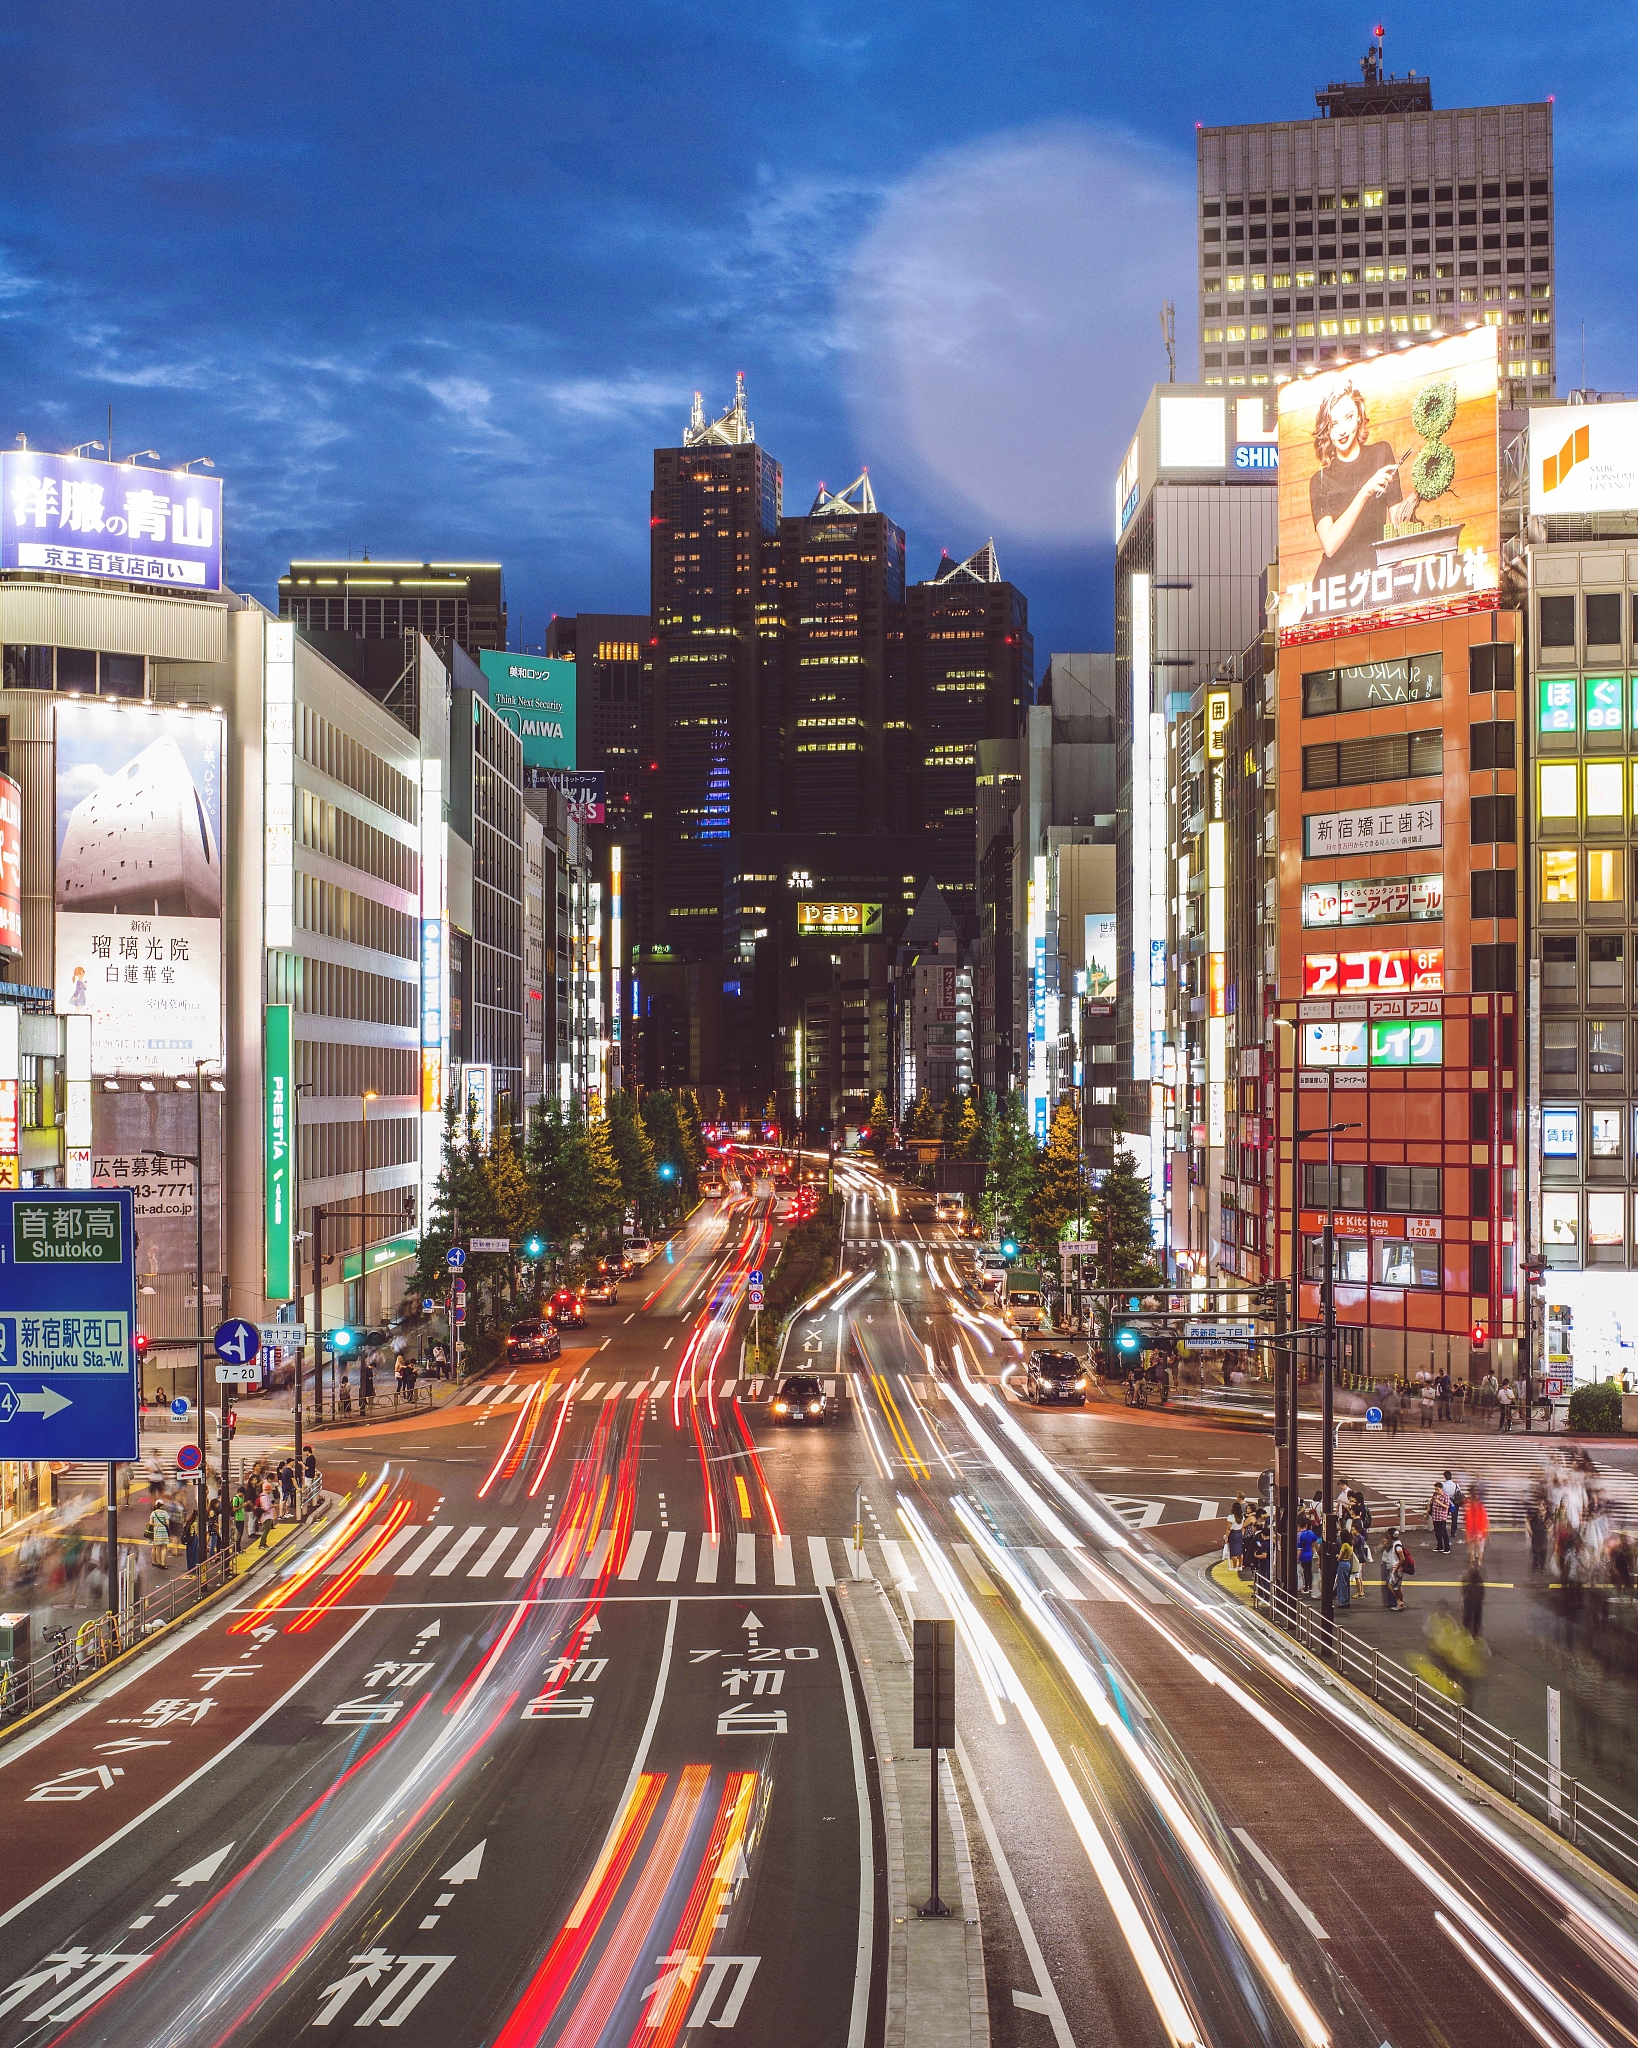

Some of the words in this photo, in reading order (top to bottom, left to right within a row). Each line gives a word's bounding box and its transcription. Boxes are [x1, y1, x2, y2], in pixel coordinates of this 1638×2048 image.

[12, 476, 213, 548] 洋服の青山
[44, 548, 184, 578] 京王百貨店向い
[1287, 546, 1488, 615] THEグローバル社
[509, 666, 550, 681] 美和ロック
[495, 693, 517, 706] Think
[518, 696, 535, 708] Next
[534, 698, 563, 712] Security
[1553, 708, 1620, 729] 2,98
[521, 719, 563, 739] MIWA
[1317, 810, 1434, 841] 新宿矯正歯科
[804, 905, 858, 923] やまや
[1341, 892, 1441, 919] エーアイアール
[130, 920, 152, 932] 新宿
[91, 935, 189, 961] 瑠璃光院
[1312, 951, 1404, 991] アコム
[1418, 953, 1437, 970] 6F
[105, 964, 175, 984] 白蓮華堂
[1373, 1002, 1400, 1014] アコム
[1410, 1001, 1438, 1013] アコム
[1135, 1009, 1144, 1038] LABI
[1371, 1028, 1434, 1057] レイク
[1547, 1128, 1574, 1143] 賃貸
[68, 1151, 90, 1162] KM
[93, 1157, 188, 1178] 広告募集中
[133, 1183, 194, 1199] 43-7771
[20, 1208, 115, 1239] 首都高
[1346, 1216, 1389, 1228] Kitchen
[32, 1241, 103, 1258] Shutoko
[21, 1318, 122, 1349] 新宿駅西口
[1190, 1328, 1243, 1337] 西新宿一丁目
[22, 1351, 78, 1370] Shinjuku
[83, 1351, 124, 1368] Sta.-W.
[222, 1369, 255, 1380] 7-20
[689, 1646, 819, 1663] 7-20
[322, 1661, 435, 1725] 初台
[520, 1656, 609, 1720] 初台
[716, 1667, 788, 1735] 初台
[3, 1946, 154, 2023] 初
[312, 1946, 458, 2028] 初
